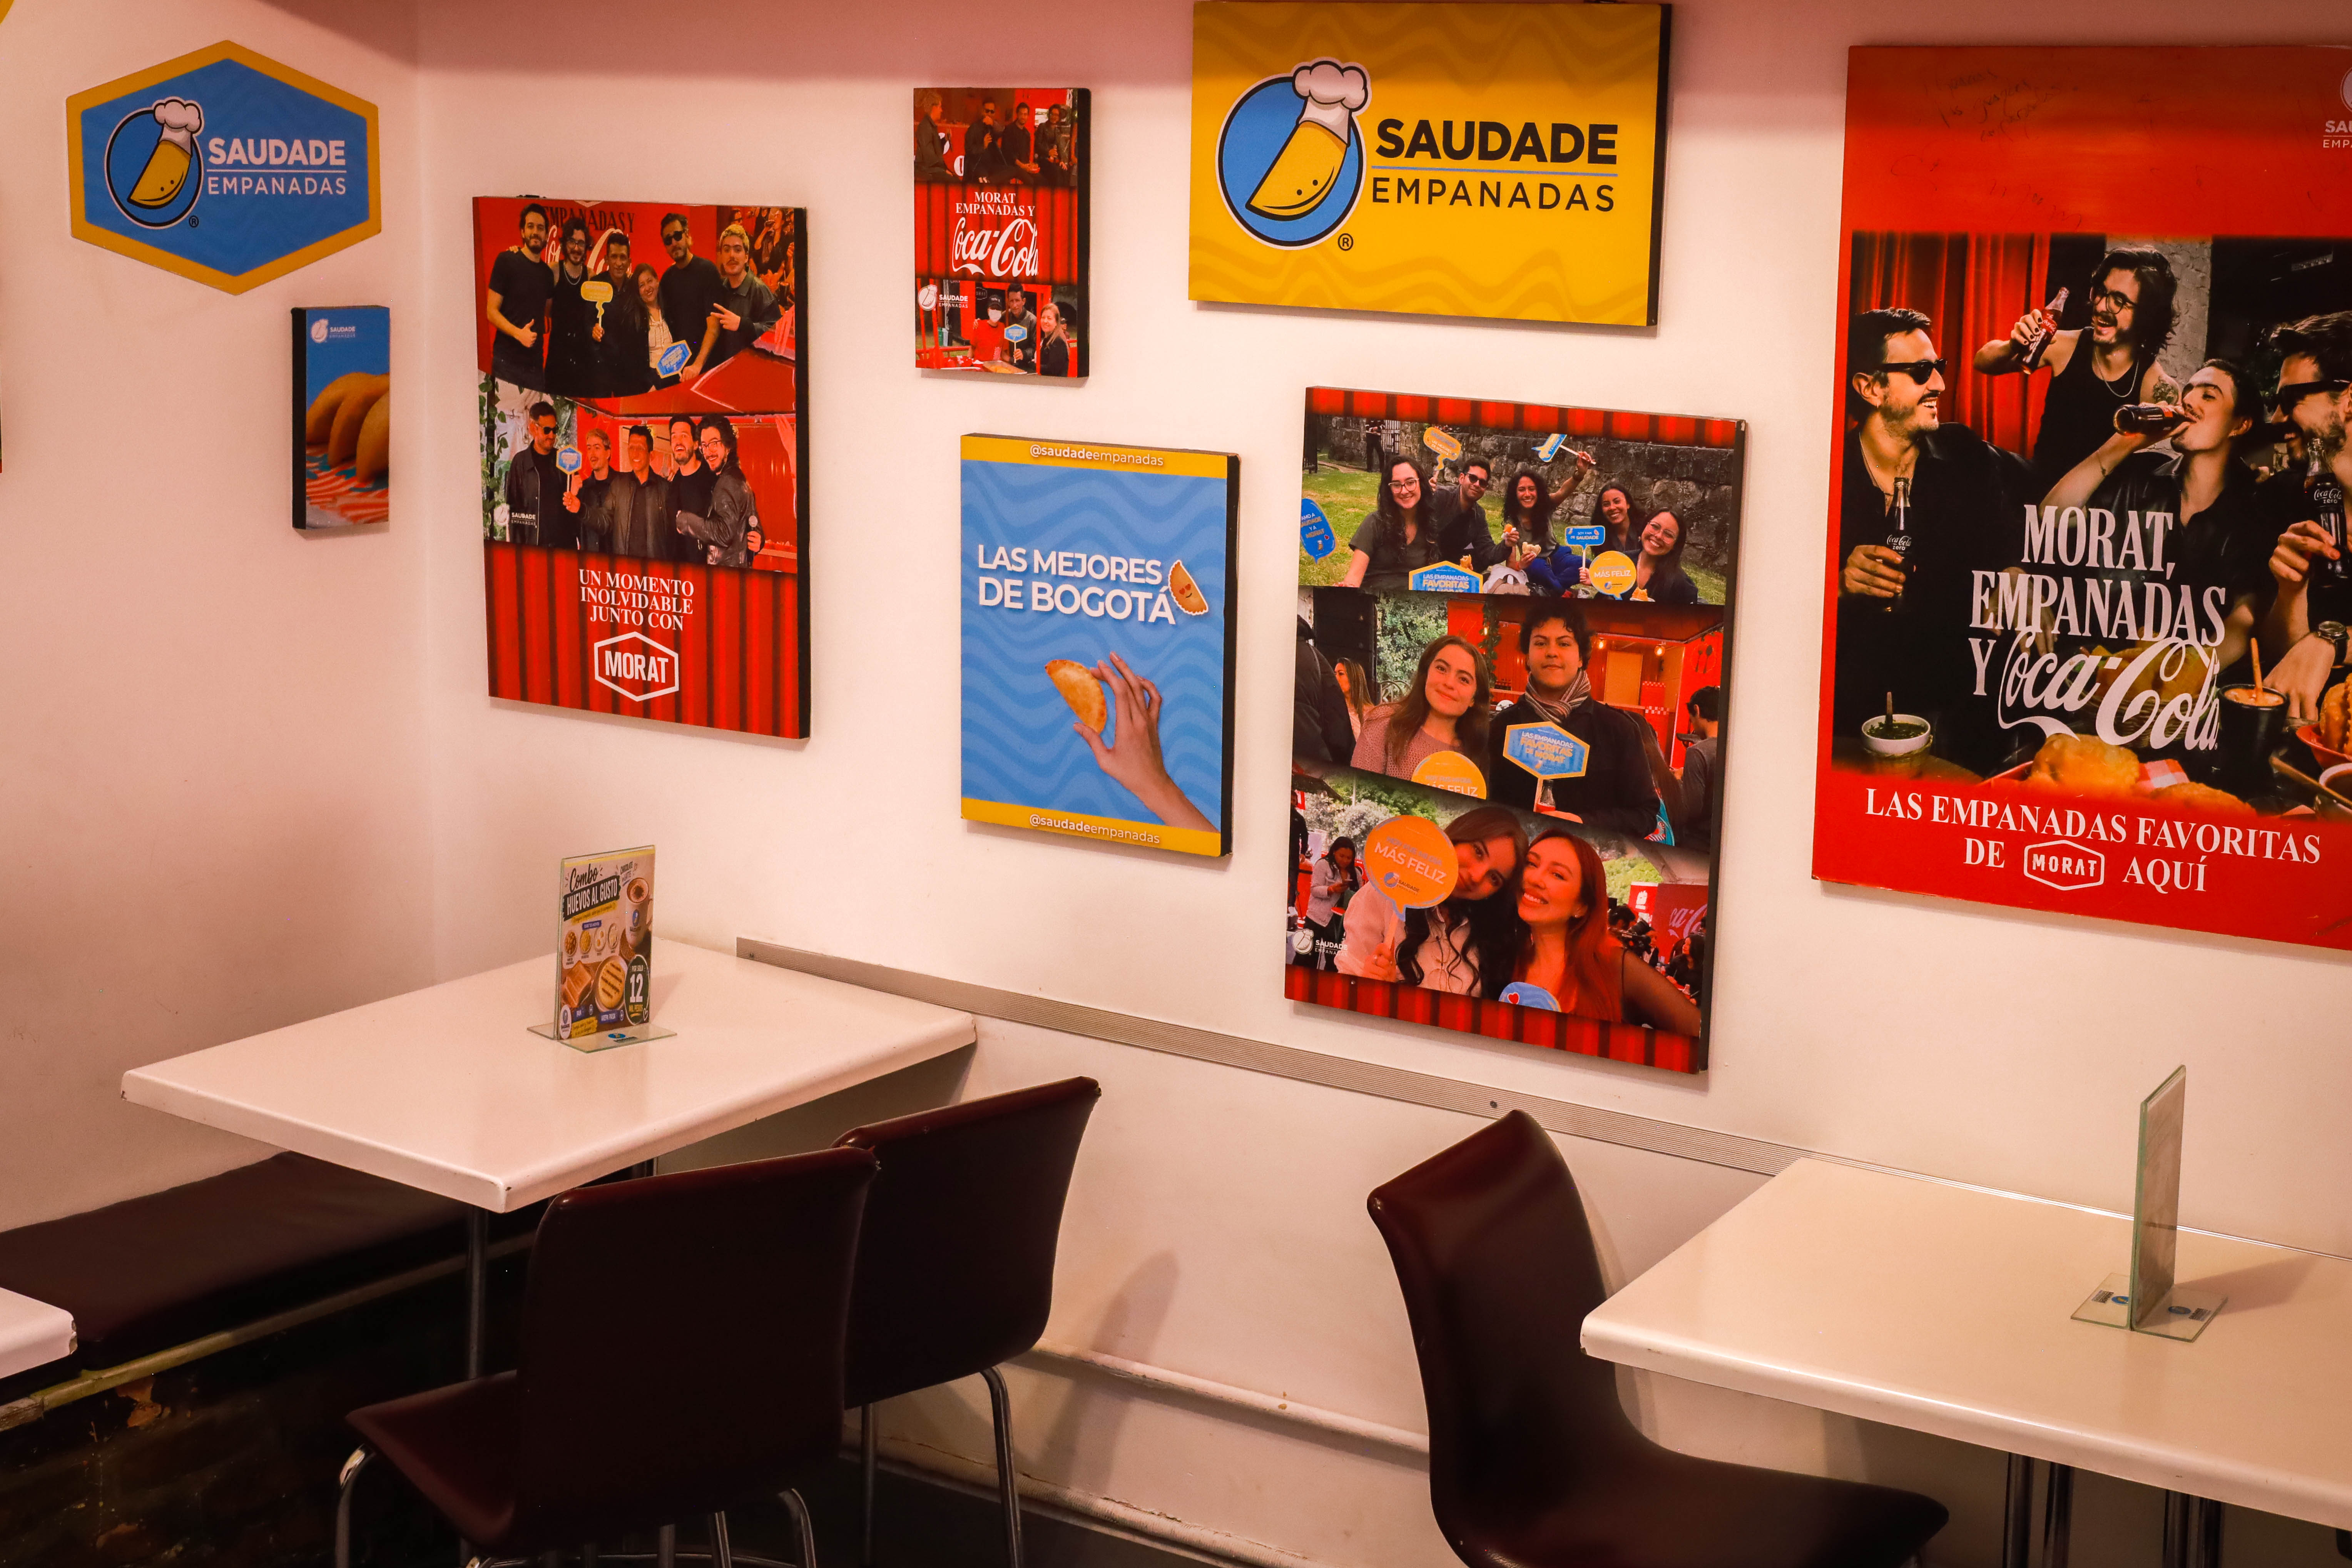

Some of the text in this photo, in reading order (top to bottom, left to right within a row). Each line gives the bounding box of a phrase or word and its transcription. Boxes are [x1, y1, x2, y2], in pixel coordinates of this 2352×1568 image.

[208, 138, 346, 166] SAUDADE
[1375, 118, 1618, 165] SAUDADE
[208, 177, 346, 195] EMPANADAS
[975, 192, 1016, 204] MORAT
[1372, 177, 1615, 212] EMPANADAS
[956, 203, 1035, 217] EMPANADAS Y
[952, 217, 1038, 277] Coca-Cola
[1030, 444, 1163, 466] @saudadeempanadas
[2021, 504, 2175, 580] MORAT,
[978, 544, 1162, 585] LAS MEJORES
[579, 568, 694, 597] UN MOMENTO
[1423, 579, 1469, 589] FAVORITAS
[580, 586, 694, 615] INOLVIDABLE
[978, 577, 1176, 625] DE BOGOTÁ
[1969, 570, 2226, 647] EMPANADAS
[590, 605, 684, 631] JUNTO CON
[605, 650, 669, 683] MORAT
[1969, 629, 2220, 751] Y Coca-Cola
[1535, 734, 1574, 749] EMPANADAS
[1029, 814, 1160, 844] @saudadeempanadas
[1865, 788, 2320, 864] LAS EMPANADAS FAVORITAS
[570, 863, 599, 893] Combo
[1374, 842, 1447, 884] MÁS FELIZ
[1963, 837, 2208, 894] DE MORAT AQUÍ
[567, 888, 590, 916] HUEVOS
[591, 886, 599, 906] AL
[600, 878, 618, 902] GUSTO
[630, 973, 643, 1003] 12
